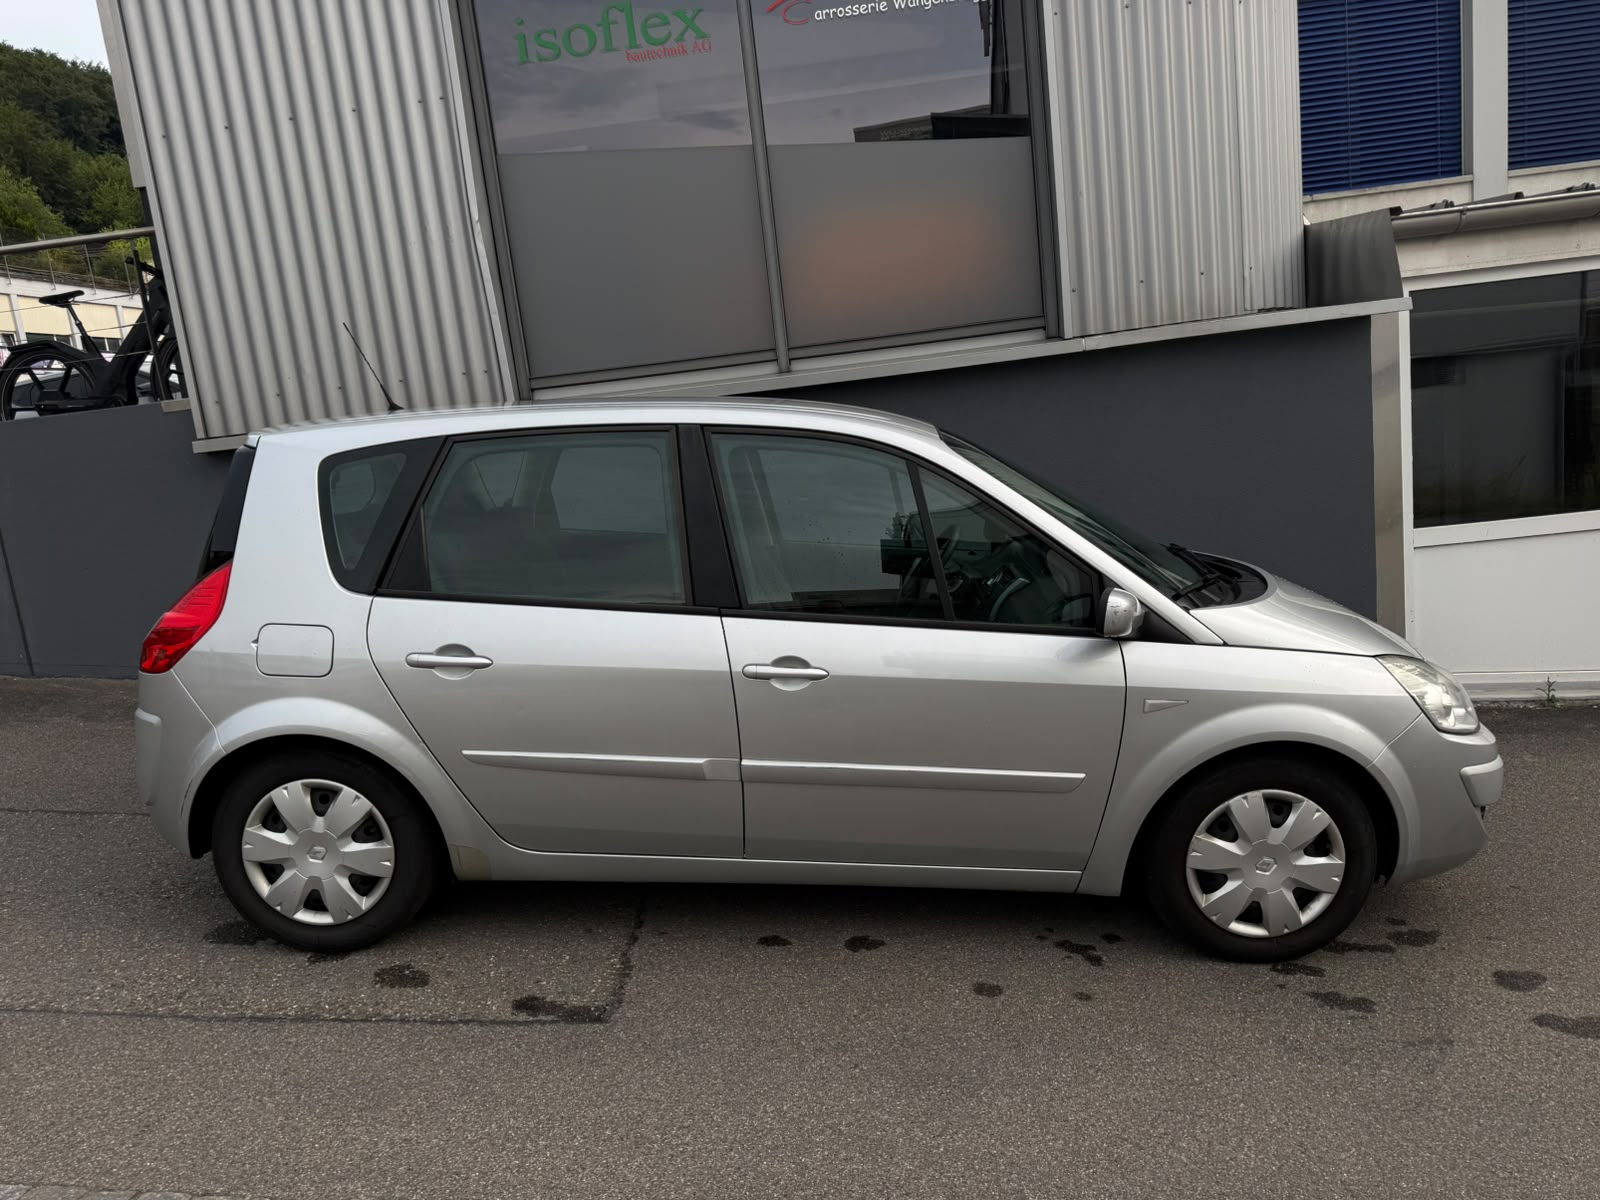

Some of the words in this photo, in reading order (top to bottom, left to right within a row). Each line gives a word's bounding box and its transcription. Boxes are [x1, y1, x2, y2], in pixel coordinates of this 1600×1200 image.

[514, 0, 711, 64] isoflex
[625, 42, 689, 63] bautechnik
[692, 38, 713, 55] AG
